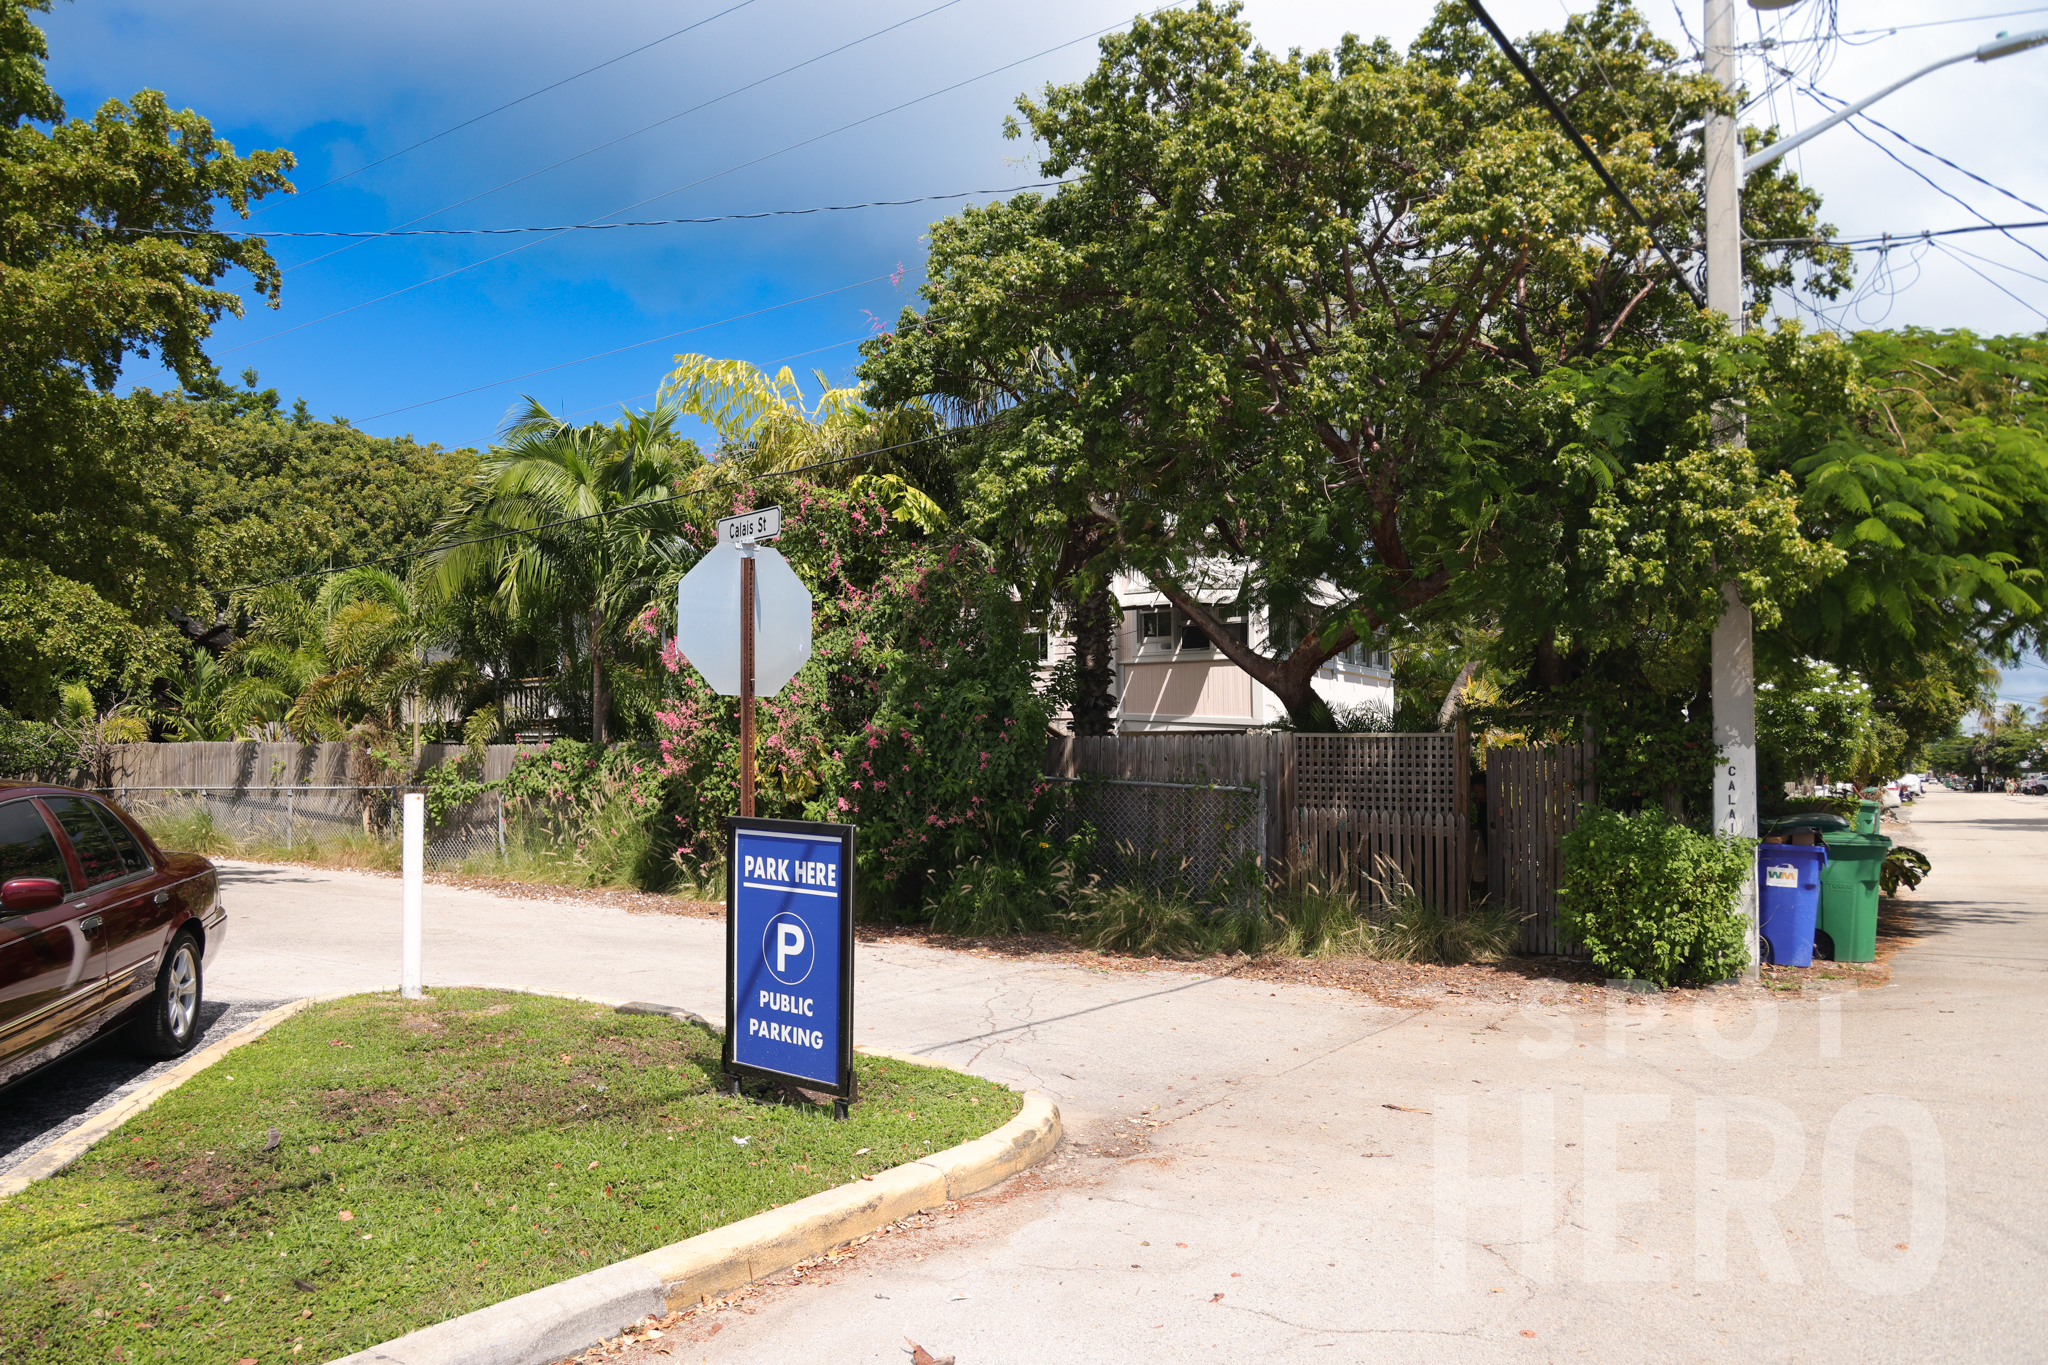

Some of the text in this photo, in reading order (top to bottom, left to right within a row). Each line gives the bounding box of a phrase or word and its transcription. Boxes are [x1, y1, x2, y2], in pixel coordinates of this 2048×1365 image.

[729, 516, 767, 539] Calais St
[744, 855, 837, 887] PARK HERE
[1767, 870, 1795, 881] WM
[777, 922, 805, 972] P
[759, 990, 814, 1017] PUBLIC
[749, 1018, 824, 1050] PARKING
